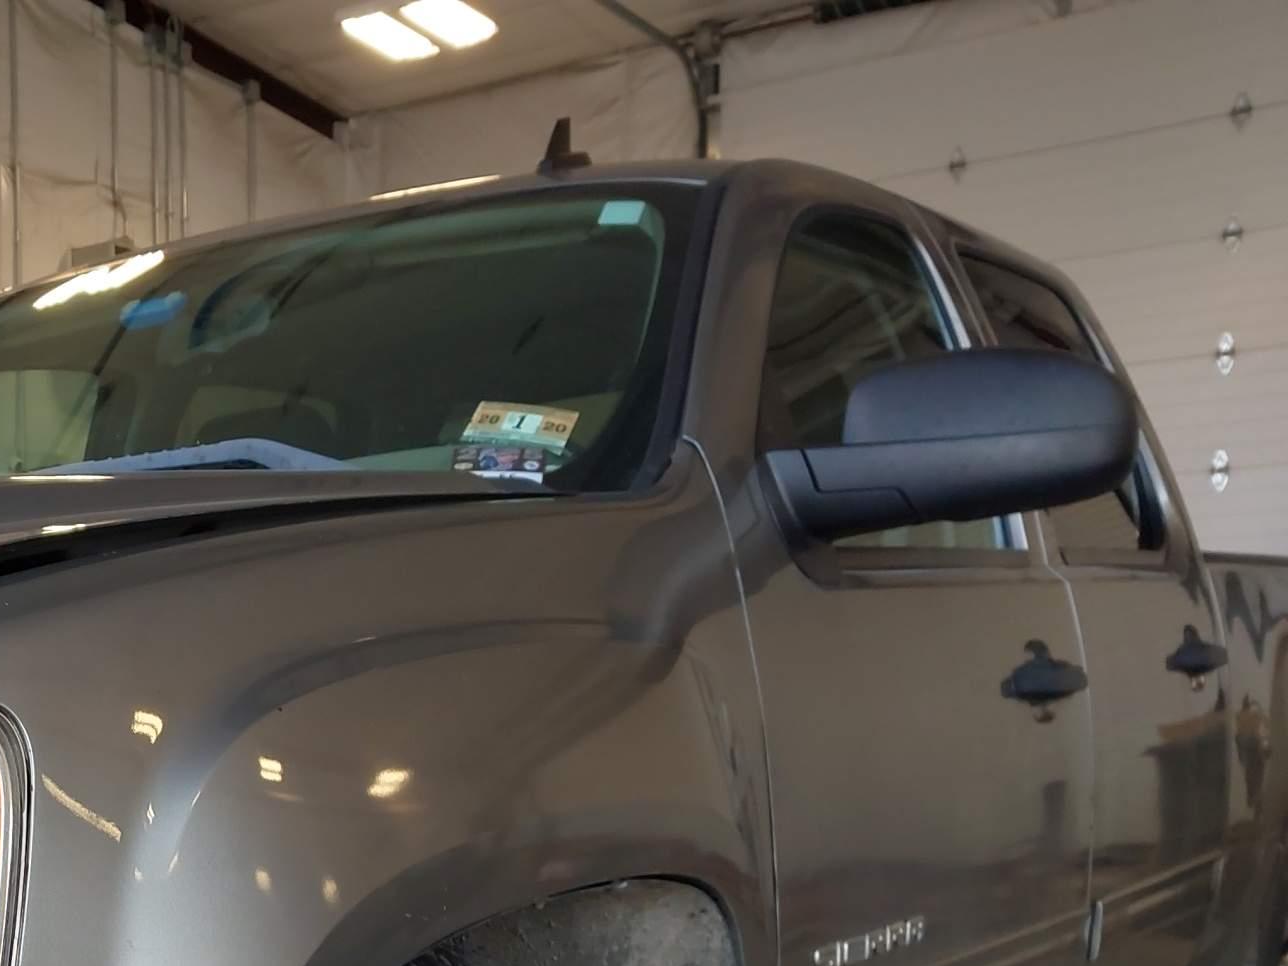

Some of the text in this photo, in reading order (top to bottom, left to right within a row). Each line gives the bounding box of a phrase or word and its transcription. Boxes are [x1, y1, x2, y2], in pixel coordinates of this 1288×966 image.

[478, 414, 567, 433] 20 1 20
